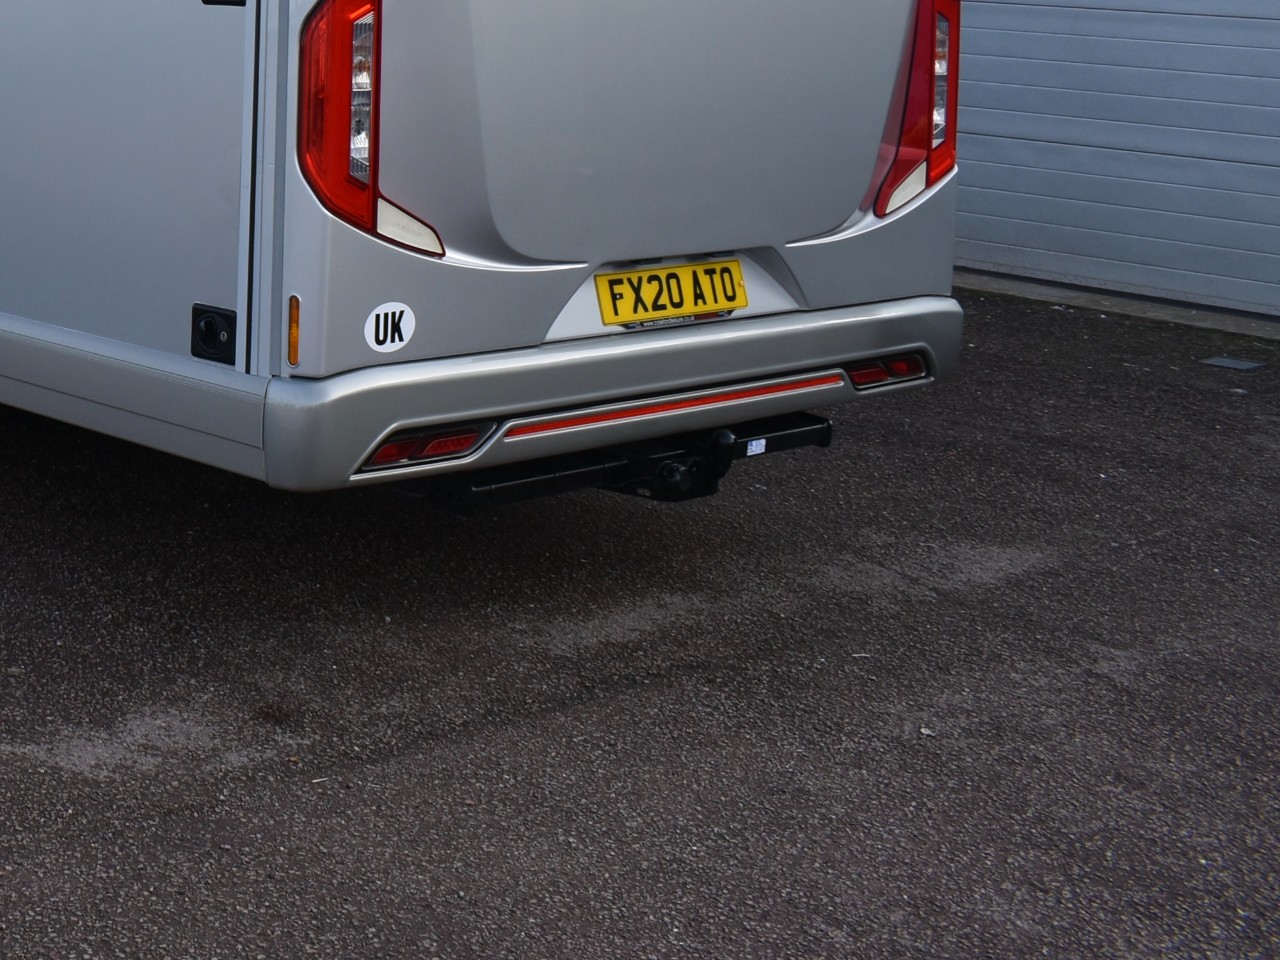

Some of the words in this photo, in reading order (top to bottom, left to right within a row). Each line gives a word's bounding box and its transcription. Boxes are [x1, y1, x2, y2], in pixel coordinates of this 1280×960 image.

[607, 271, 684, 317] FX20
[691, 266, 737, 307] ATO
[374, 309, 405, 346] UK
